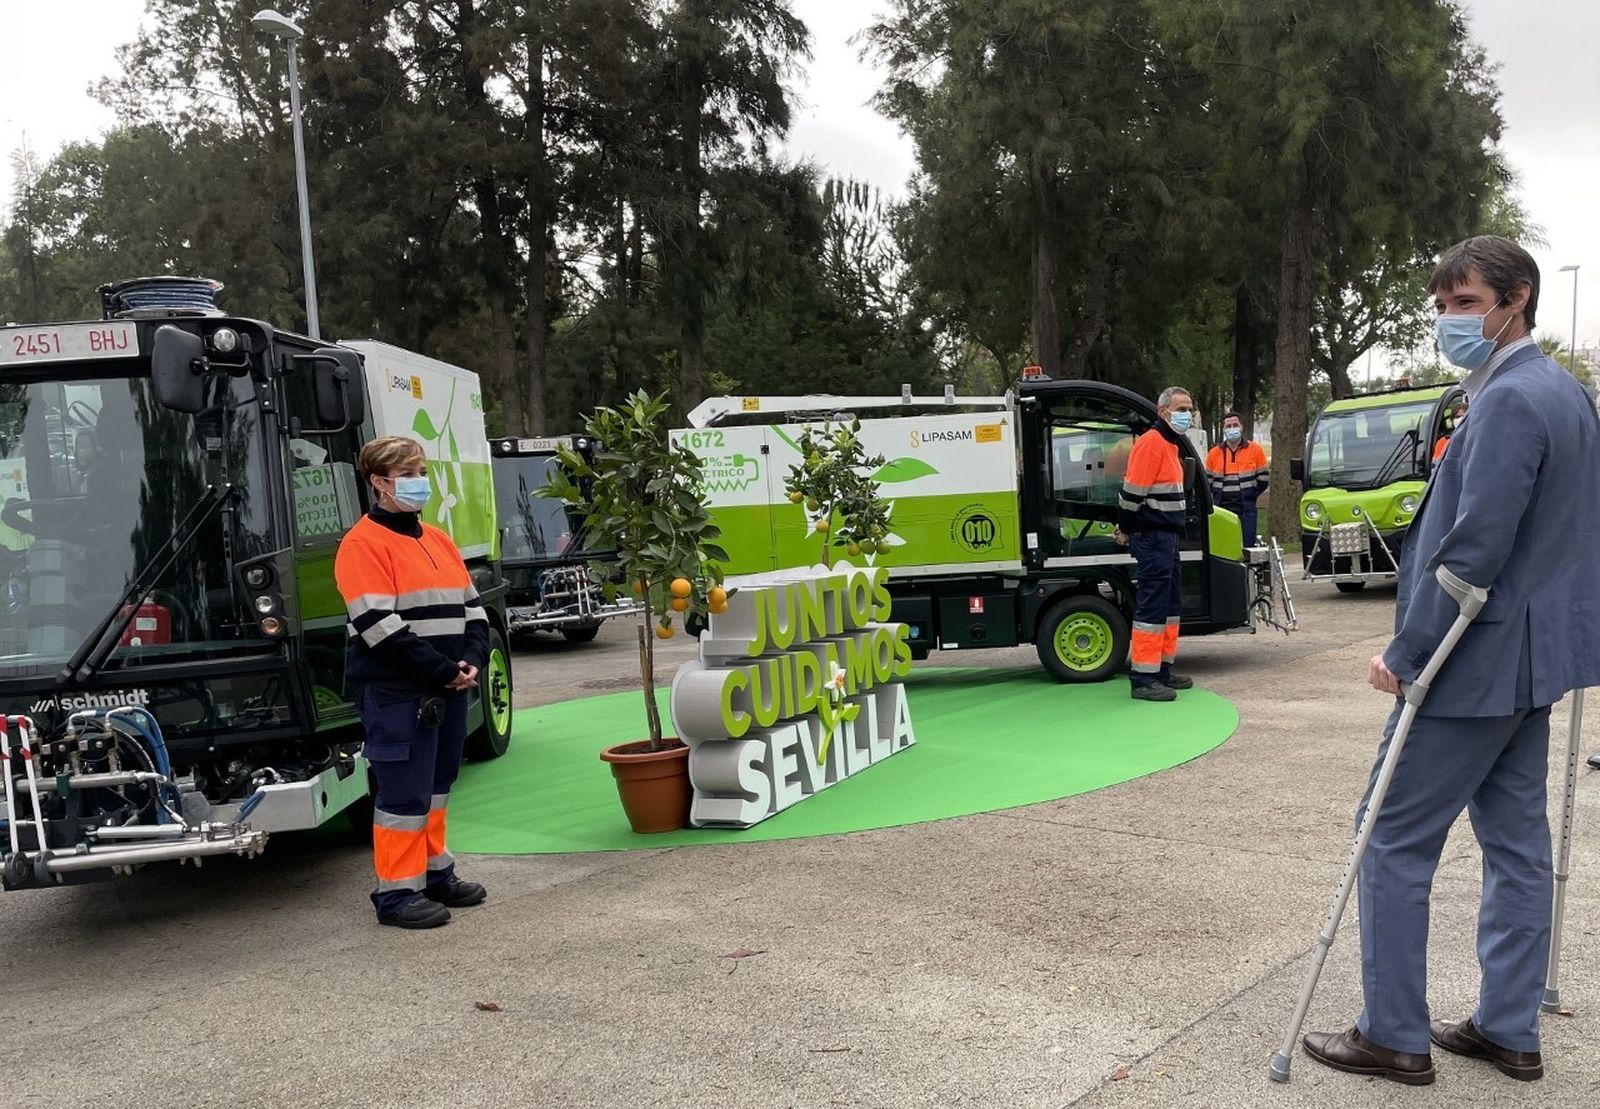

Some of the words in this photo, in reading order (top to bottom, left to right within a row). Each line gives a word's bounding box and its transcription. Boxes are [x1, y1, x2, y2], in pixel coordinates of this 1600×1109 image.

[13, 333, 61, 356] 2451
[89, 329, 128, 351] BHJ
[681, 431, 725, 448] 1672
[921, 430, 973, 442] LIPASAM
[701, 456, 722, 467] 0%
[703, 468, 745, 479] CTRICO
[965, 520, 992, 543] 010
[749, 567, 892, 658] JUNTOS
[720, 622, 912, 738] CUIDAMOS
[60, 688, 150, 711] schmidt
[737, 683, 916, 826] SEVILLA
